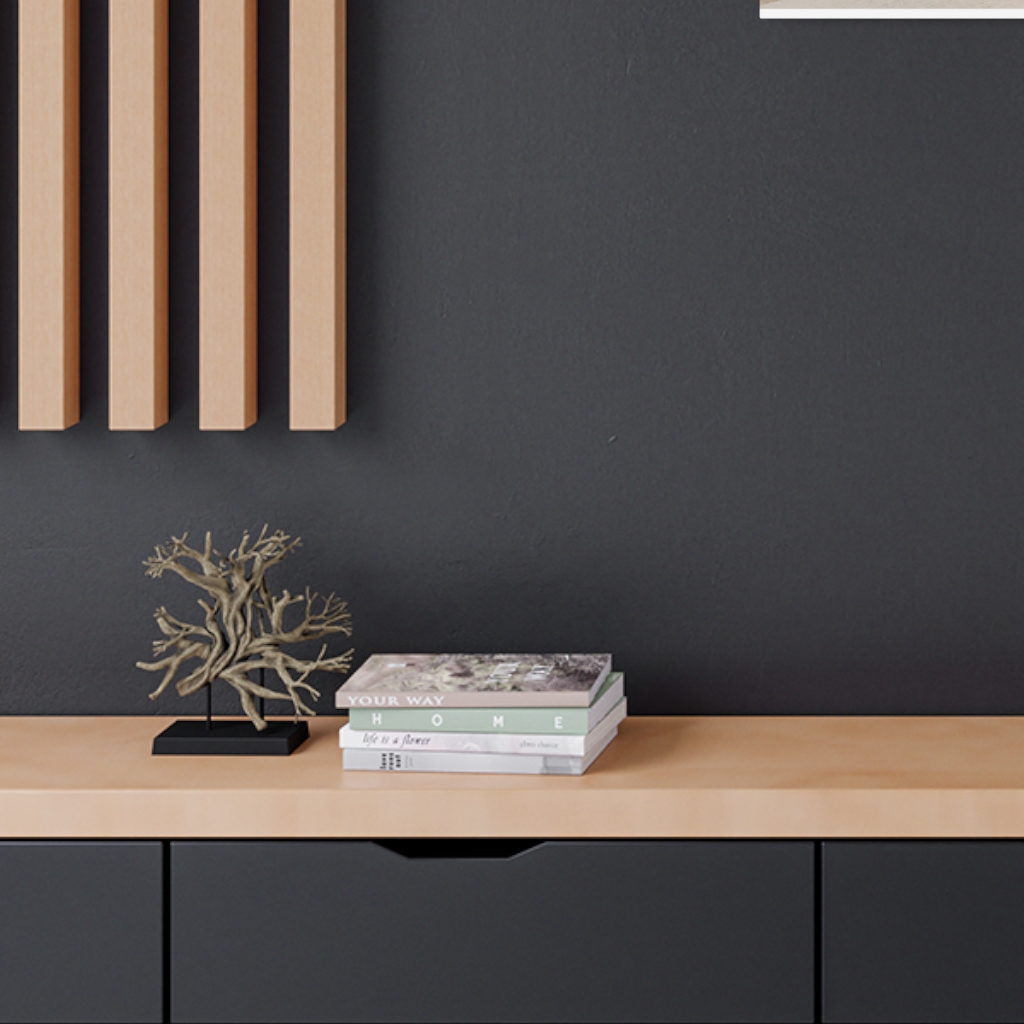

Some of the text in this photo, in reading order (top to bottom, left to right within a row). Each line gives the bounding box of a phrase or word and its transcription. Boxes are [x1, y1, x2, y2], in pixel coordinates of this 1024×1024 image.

[347, 696, 445, 706] YOUR WAY
[372, 713, 563, 729] HOME
[362, 732, 378, 748] life
[401, 733, 431, 749] flower
